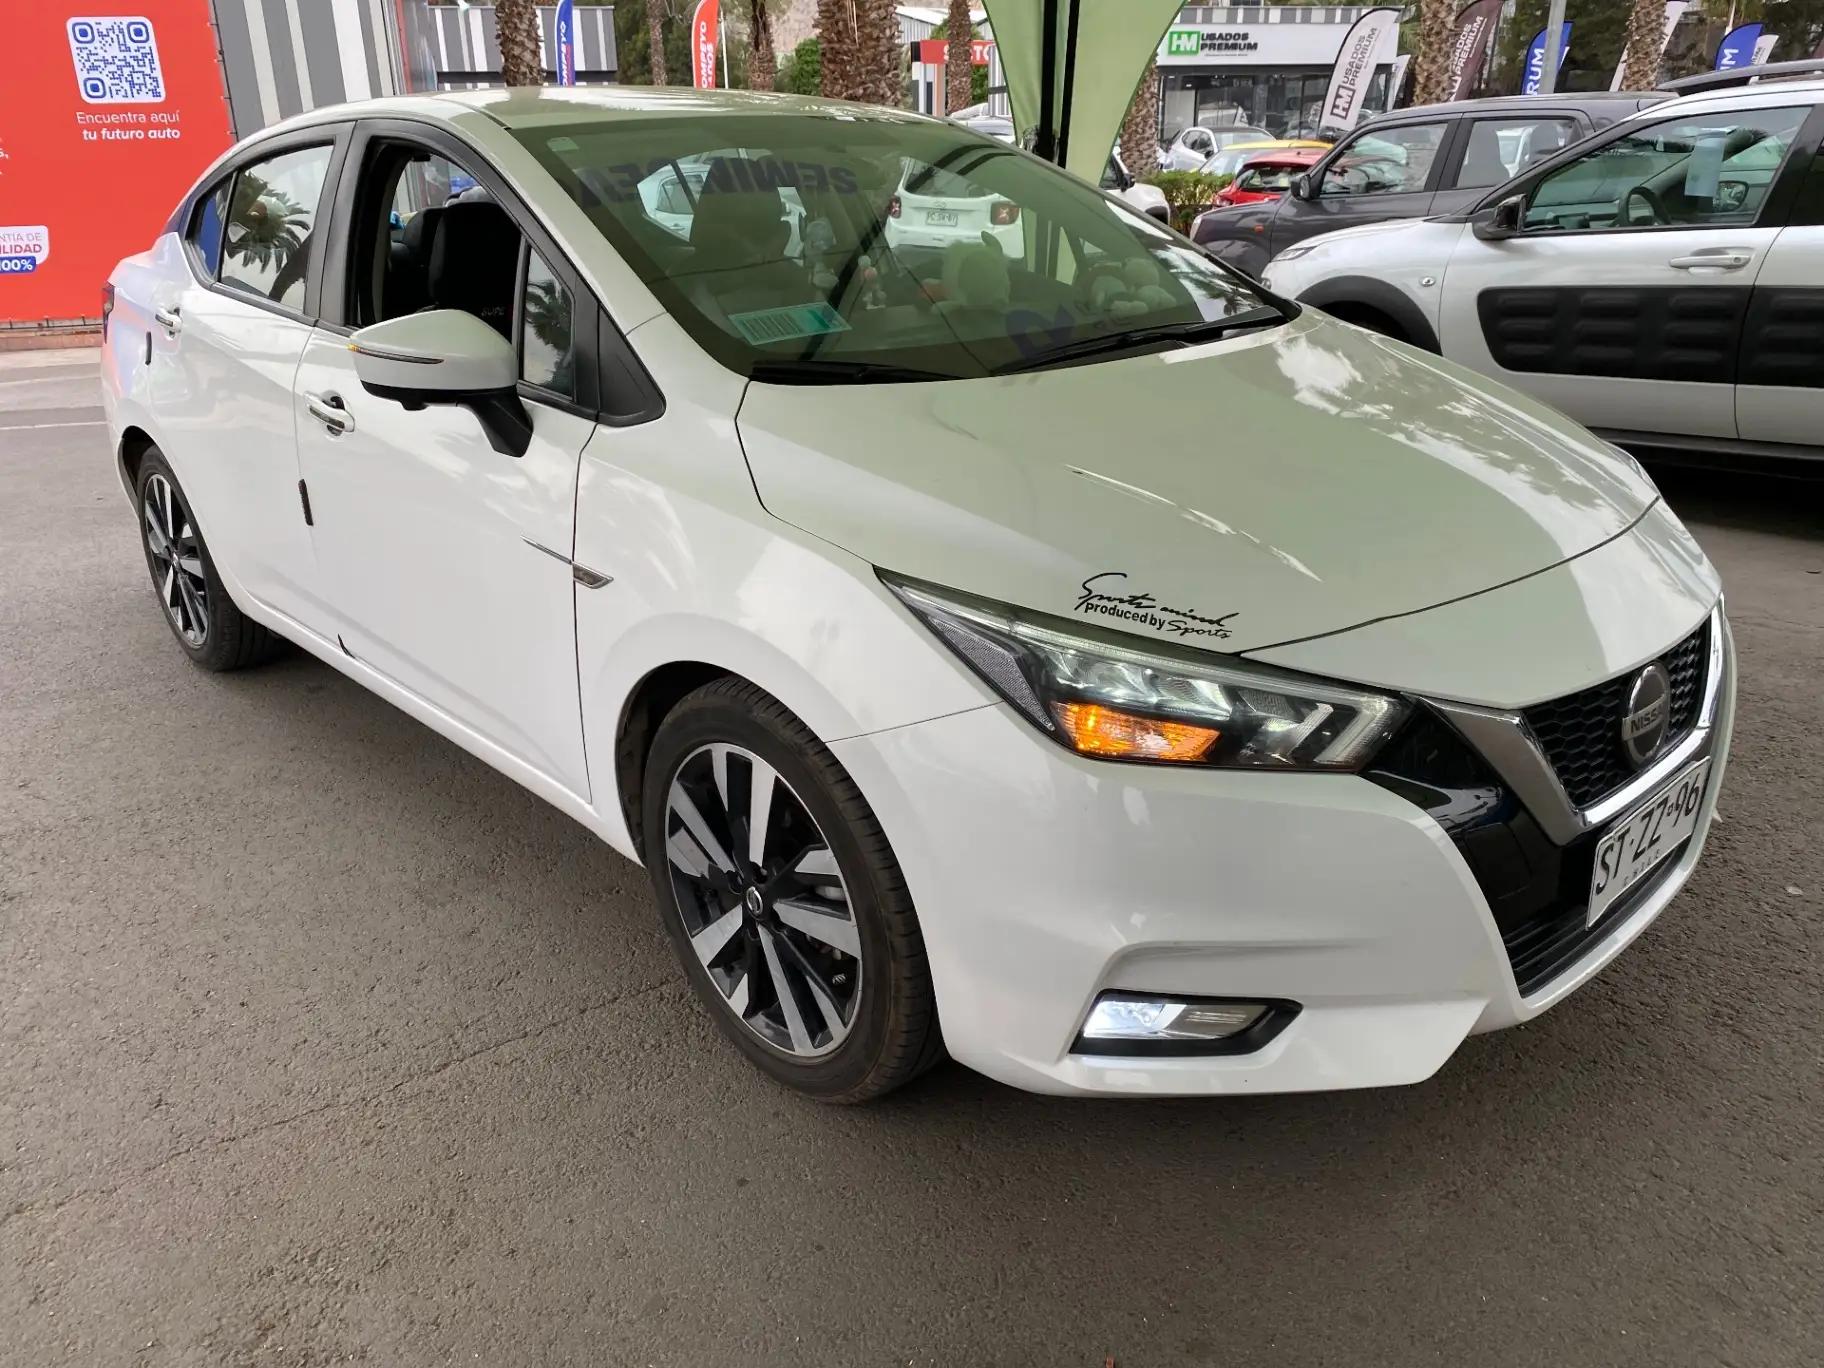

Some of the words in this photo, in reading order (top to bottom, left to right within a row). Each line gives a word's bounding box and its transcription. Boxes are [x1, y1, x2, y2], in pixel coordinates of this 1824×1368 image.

[1171, 33, 1197, 52] HM
[1200, 42, 1258, 51] PREMIUM
[1201, 32, 1249, 41] USADOS
[1457, 15, 1484, 76] PREMIUM
[1342, 35, 1366, 84] USADOS
[1348, 27, 1377, 86] PREMIUM
[1331, 88, 1354, 118] HM
[76, 111, 146, 124] Encuentra
[150, 109, 180, 125] aquí
[82, 129, 97, 140] tu
[101, 127, 145, 140] futuro
[148, 127, 180, 139] auto
[26, 232, 42, 241] DE
[1085, 602, 1148, 624] produced
[1149, 614, 1166, 631] by
[1167, 619, 1233, 639] Sports
[1630, 703, 1666, 734] NISS
